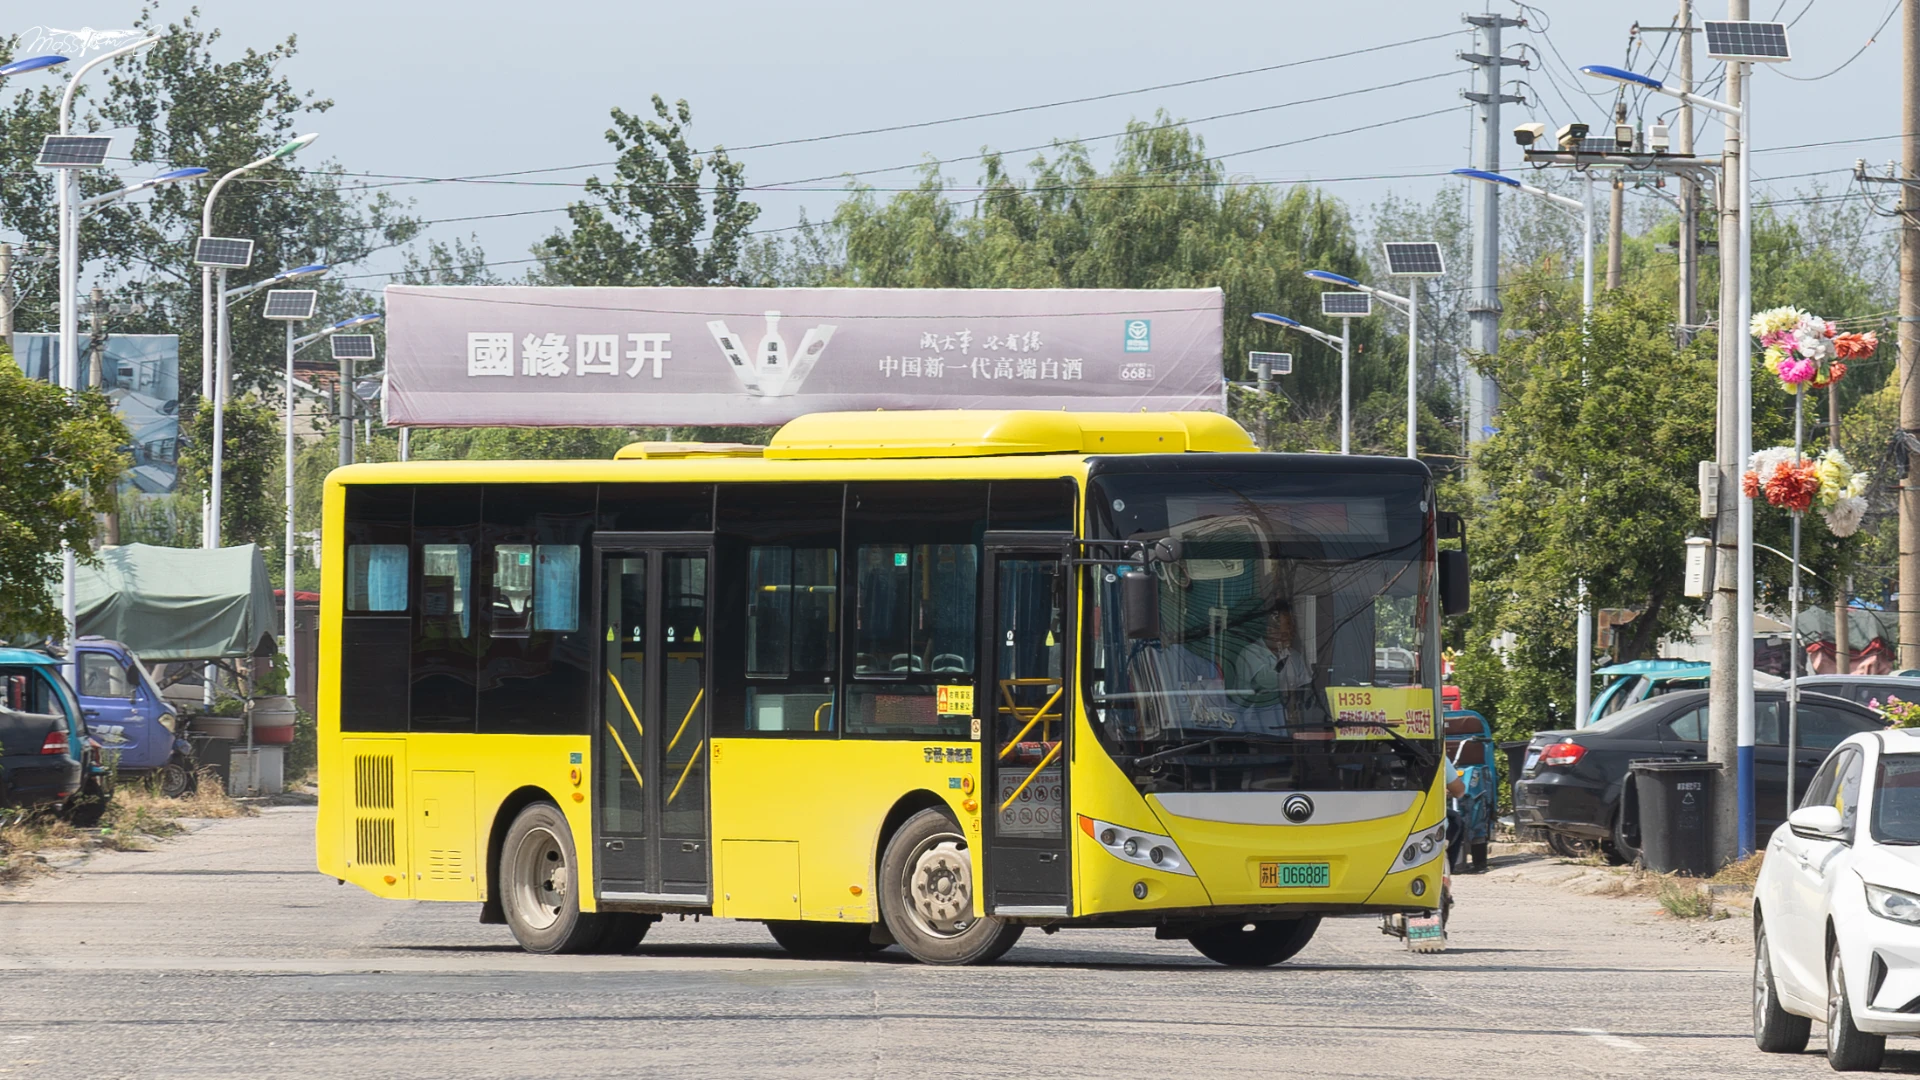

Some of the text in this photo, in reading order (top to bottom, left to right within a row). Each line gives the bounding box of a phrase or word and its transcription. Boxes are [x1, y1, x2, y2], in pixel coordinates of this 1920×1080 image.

[467, 332, 672, 378] 國緣四开
[879, 356, 1083, 380] 中国新一代高端白酒
[1121, 367, 1145, 379] 668
[1338, 692, 1371, 706] H353
[1405, 709, 1431, 735] 兴旺村
[1282, 866, 1328, 884] 06688F
